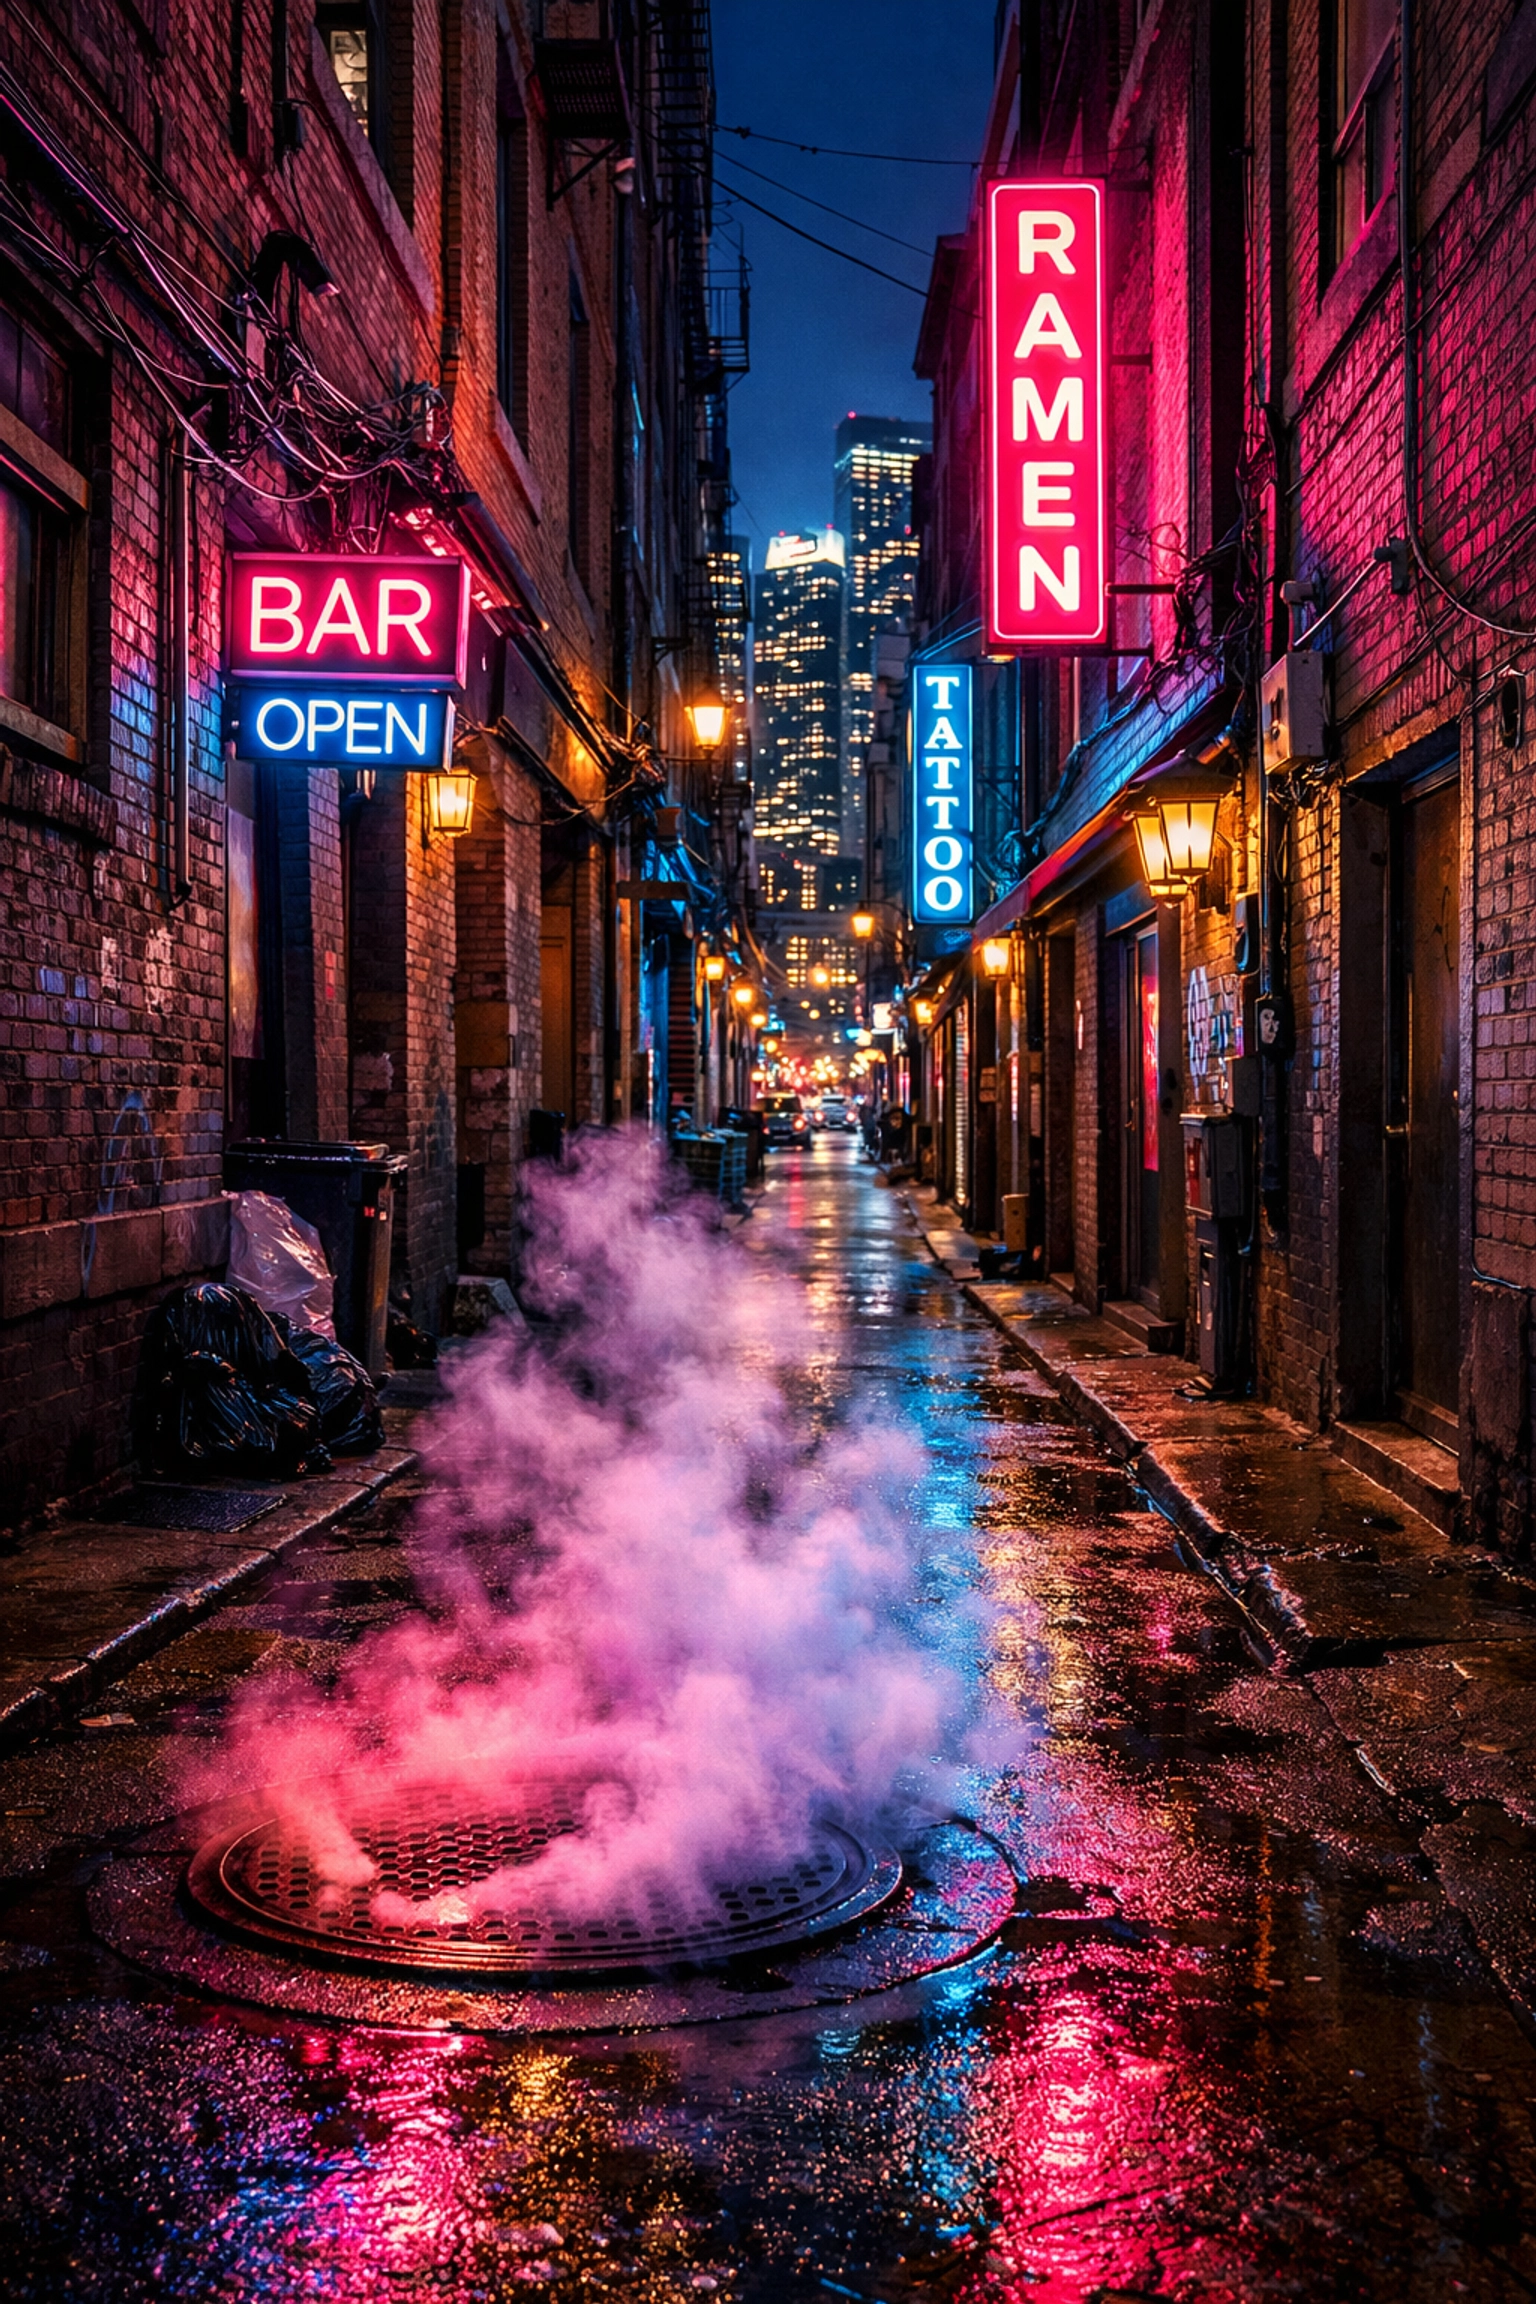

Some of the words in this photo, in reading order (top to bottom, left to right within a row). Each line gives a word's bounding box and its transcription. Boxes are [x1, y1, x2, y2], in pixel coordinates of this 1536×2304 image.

[1011, 210, 1084, 612] RAMEN
[250, 576, 432, 657] BAR
[256, 697, 428, 756] OPEN
[923, 675, 963, 912] TATTOO
